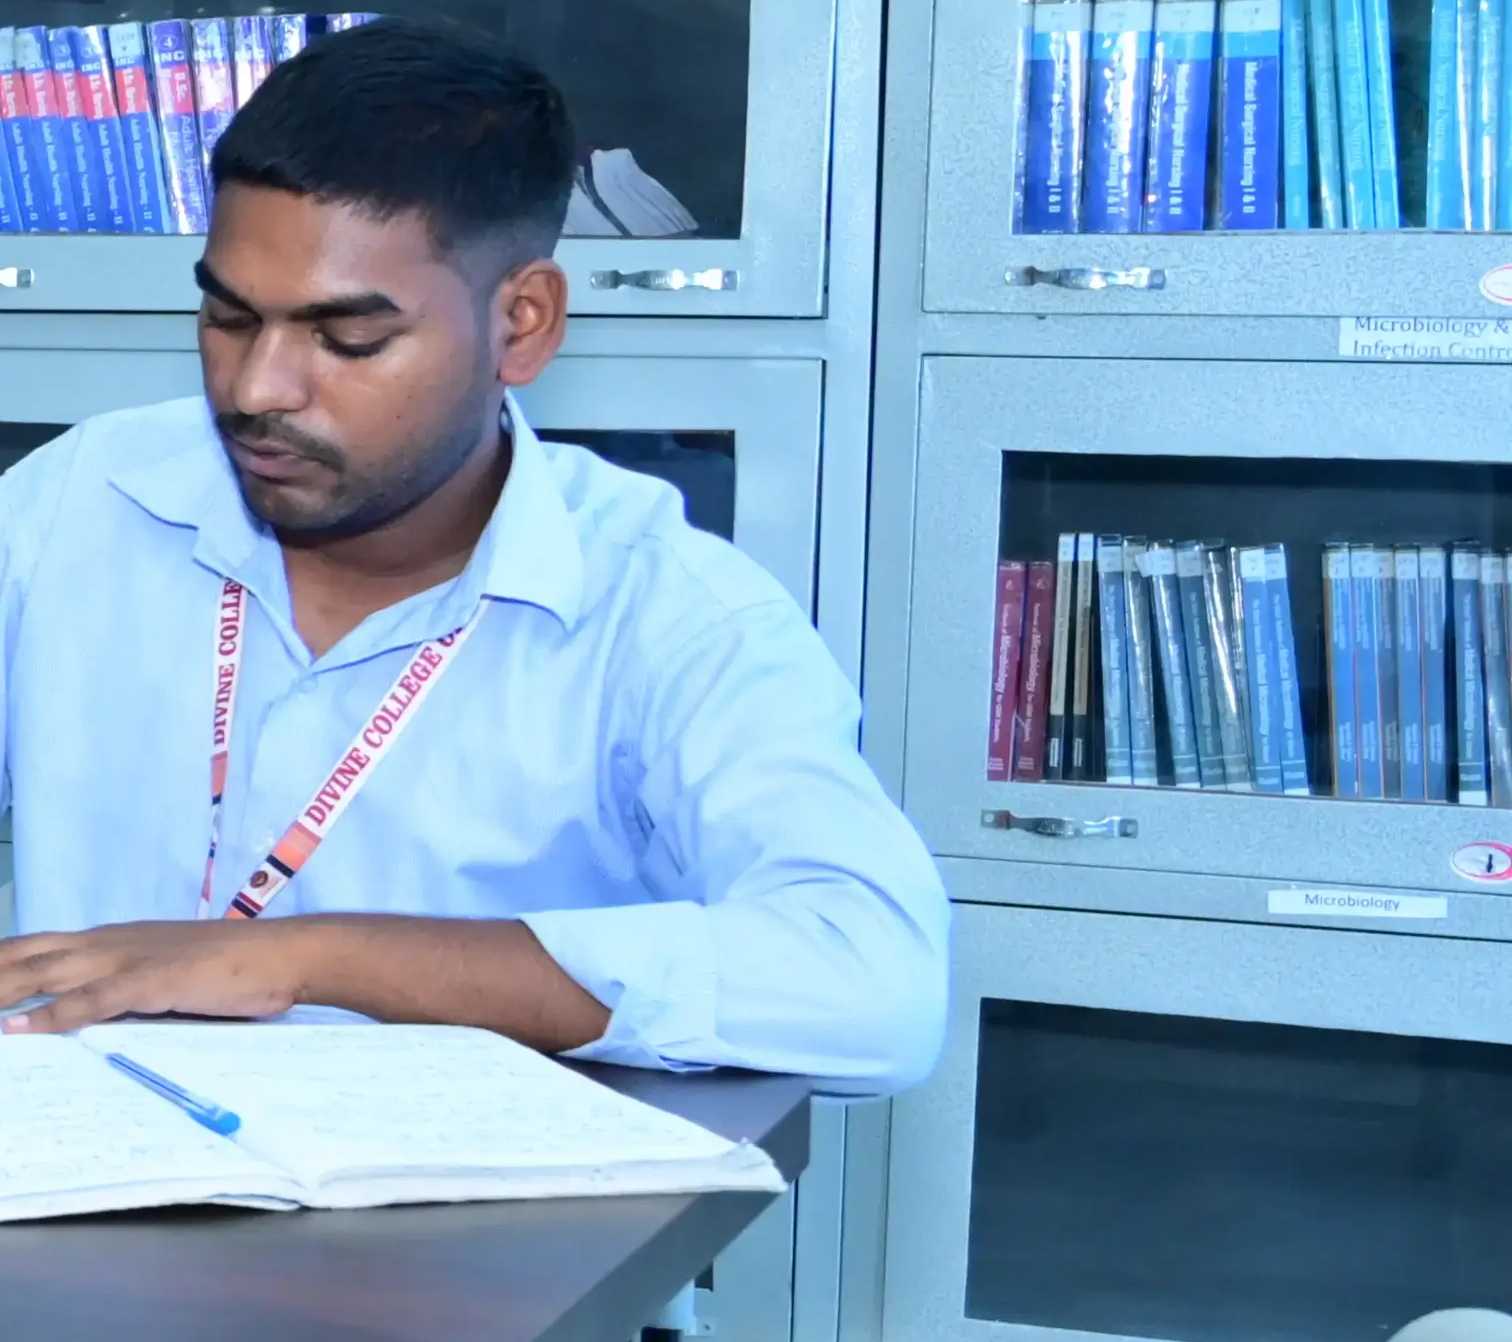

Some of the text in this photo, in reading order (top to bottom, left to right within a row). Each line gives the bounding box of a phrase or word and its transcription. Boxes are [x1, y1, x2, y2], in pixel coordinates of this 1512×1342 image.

[1242, 62, 1258, 102] Medical
[1241, 104, 1257, 145] Surgical
[1168, 149, 1184, 187] Nursing
[1240, 147, 1256, 186] Nursing
[1354, 316, 1509, 337] Microbiology &
[1353, 340, 1441, 359] Infection
[994, 635, 1011, 693] Microbiology
[1025, 633, 1041, 692] Microbiology
[214, 663, 235, 745] DIVINE
[304, 646, 443, 826] DIVINE COLLEGE
[1304, 892, 1401, 912] Microbiology
